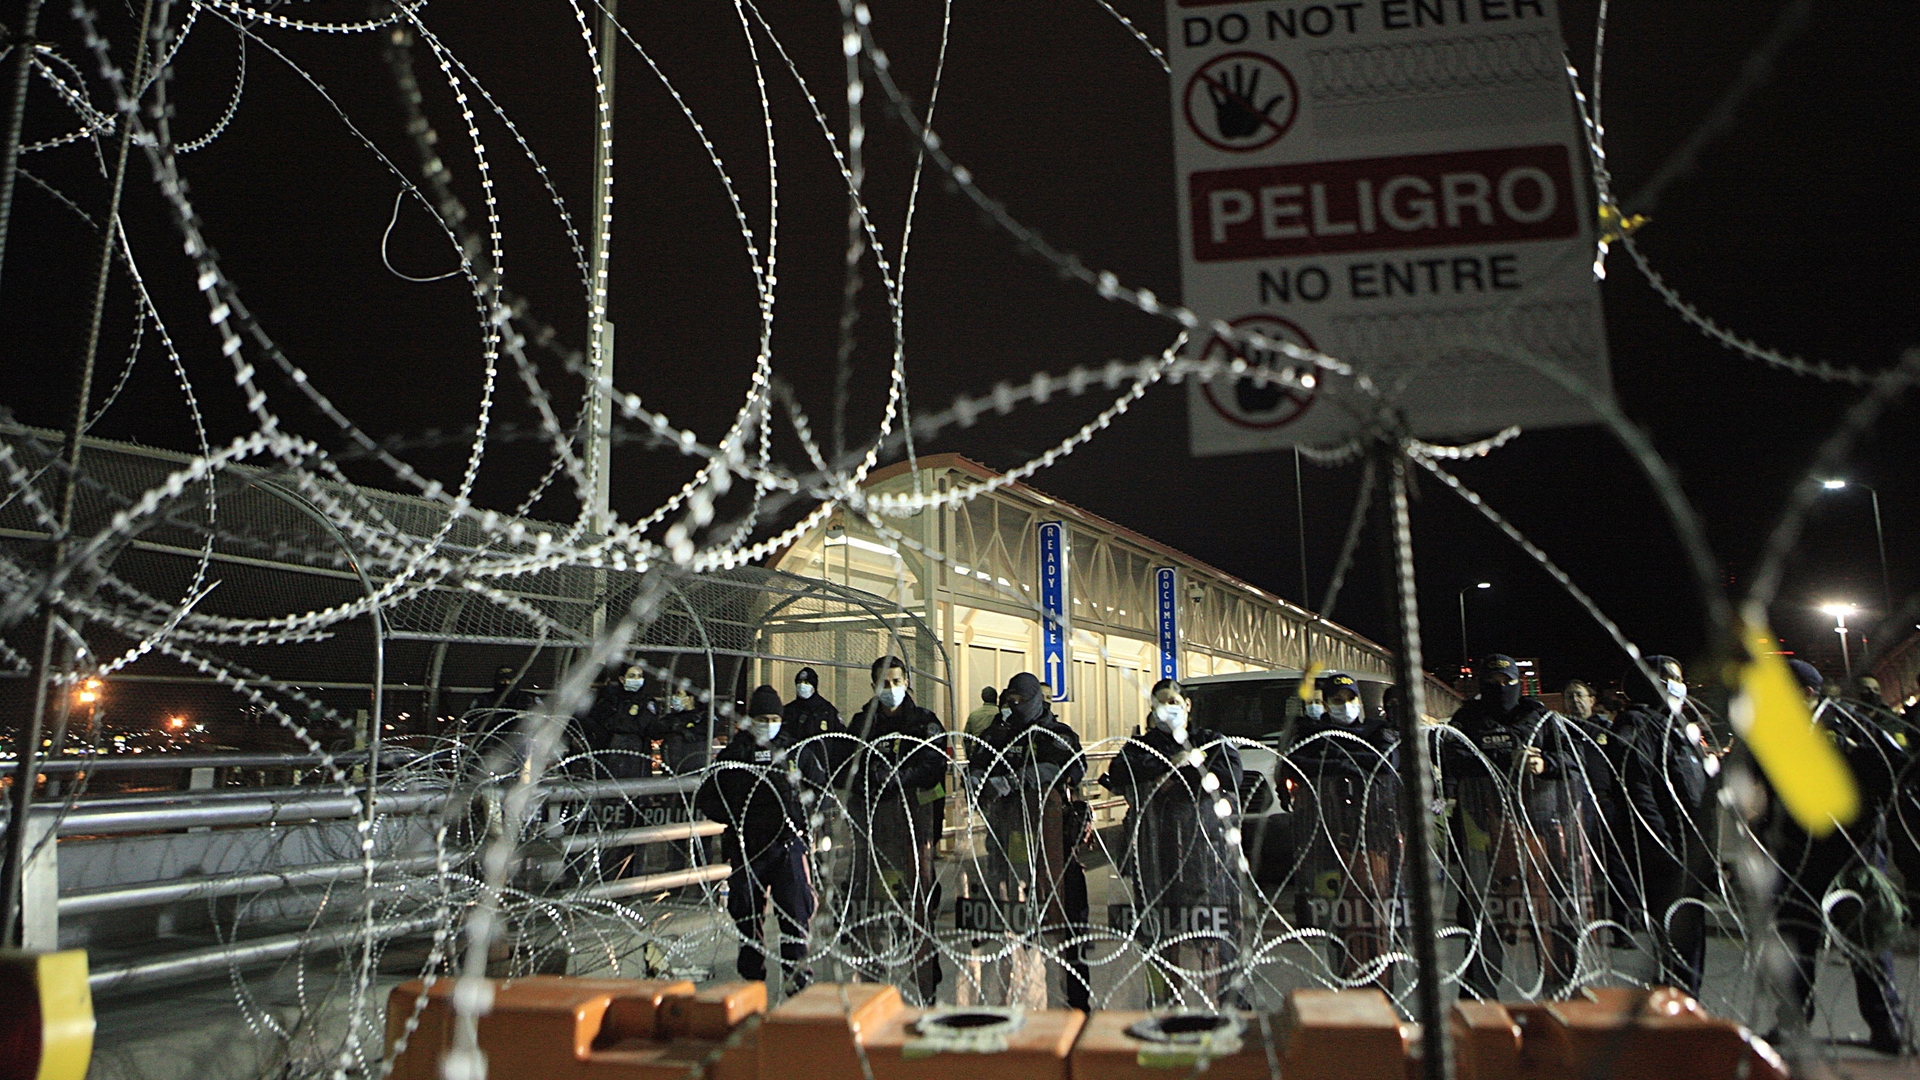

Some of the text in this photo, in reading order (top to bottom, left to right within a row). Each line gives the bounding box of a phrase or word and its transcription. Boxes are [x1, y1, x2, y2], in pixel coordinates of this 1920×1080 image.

[1183, 0, 1545, 47] DO NOT ENTER
[1208, 166, 1557, 243] PELIGRO
[1258, 254, 1522, 304] NO ENTRE
[1047, 527, 1057, 644] READY LANE
[1163, 571, 1172, 660] DOCUMENTS
[962, 899, 1044, 931] POLIC
[1122, 906, 1230, 937] POLICE
